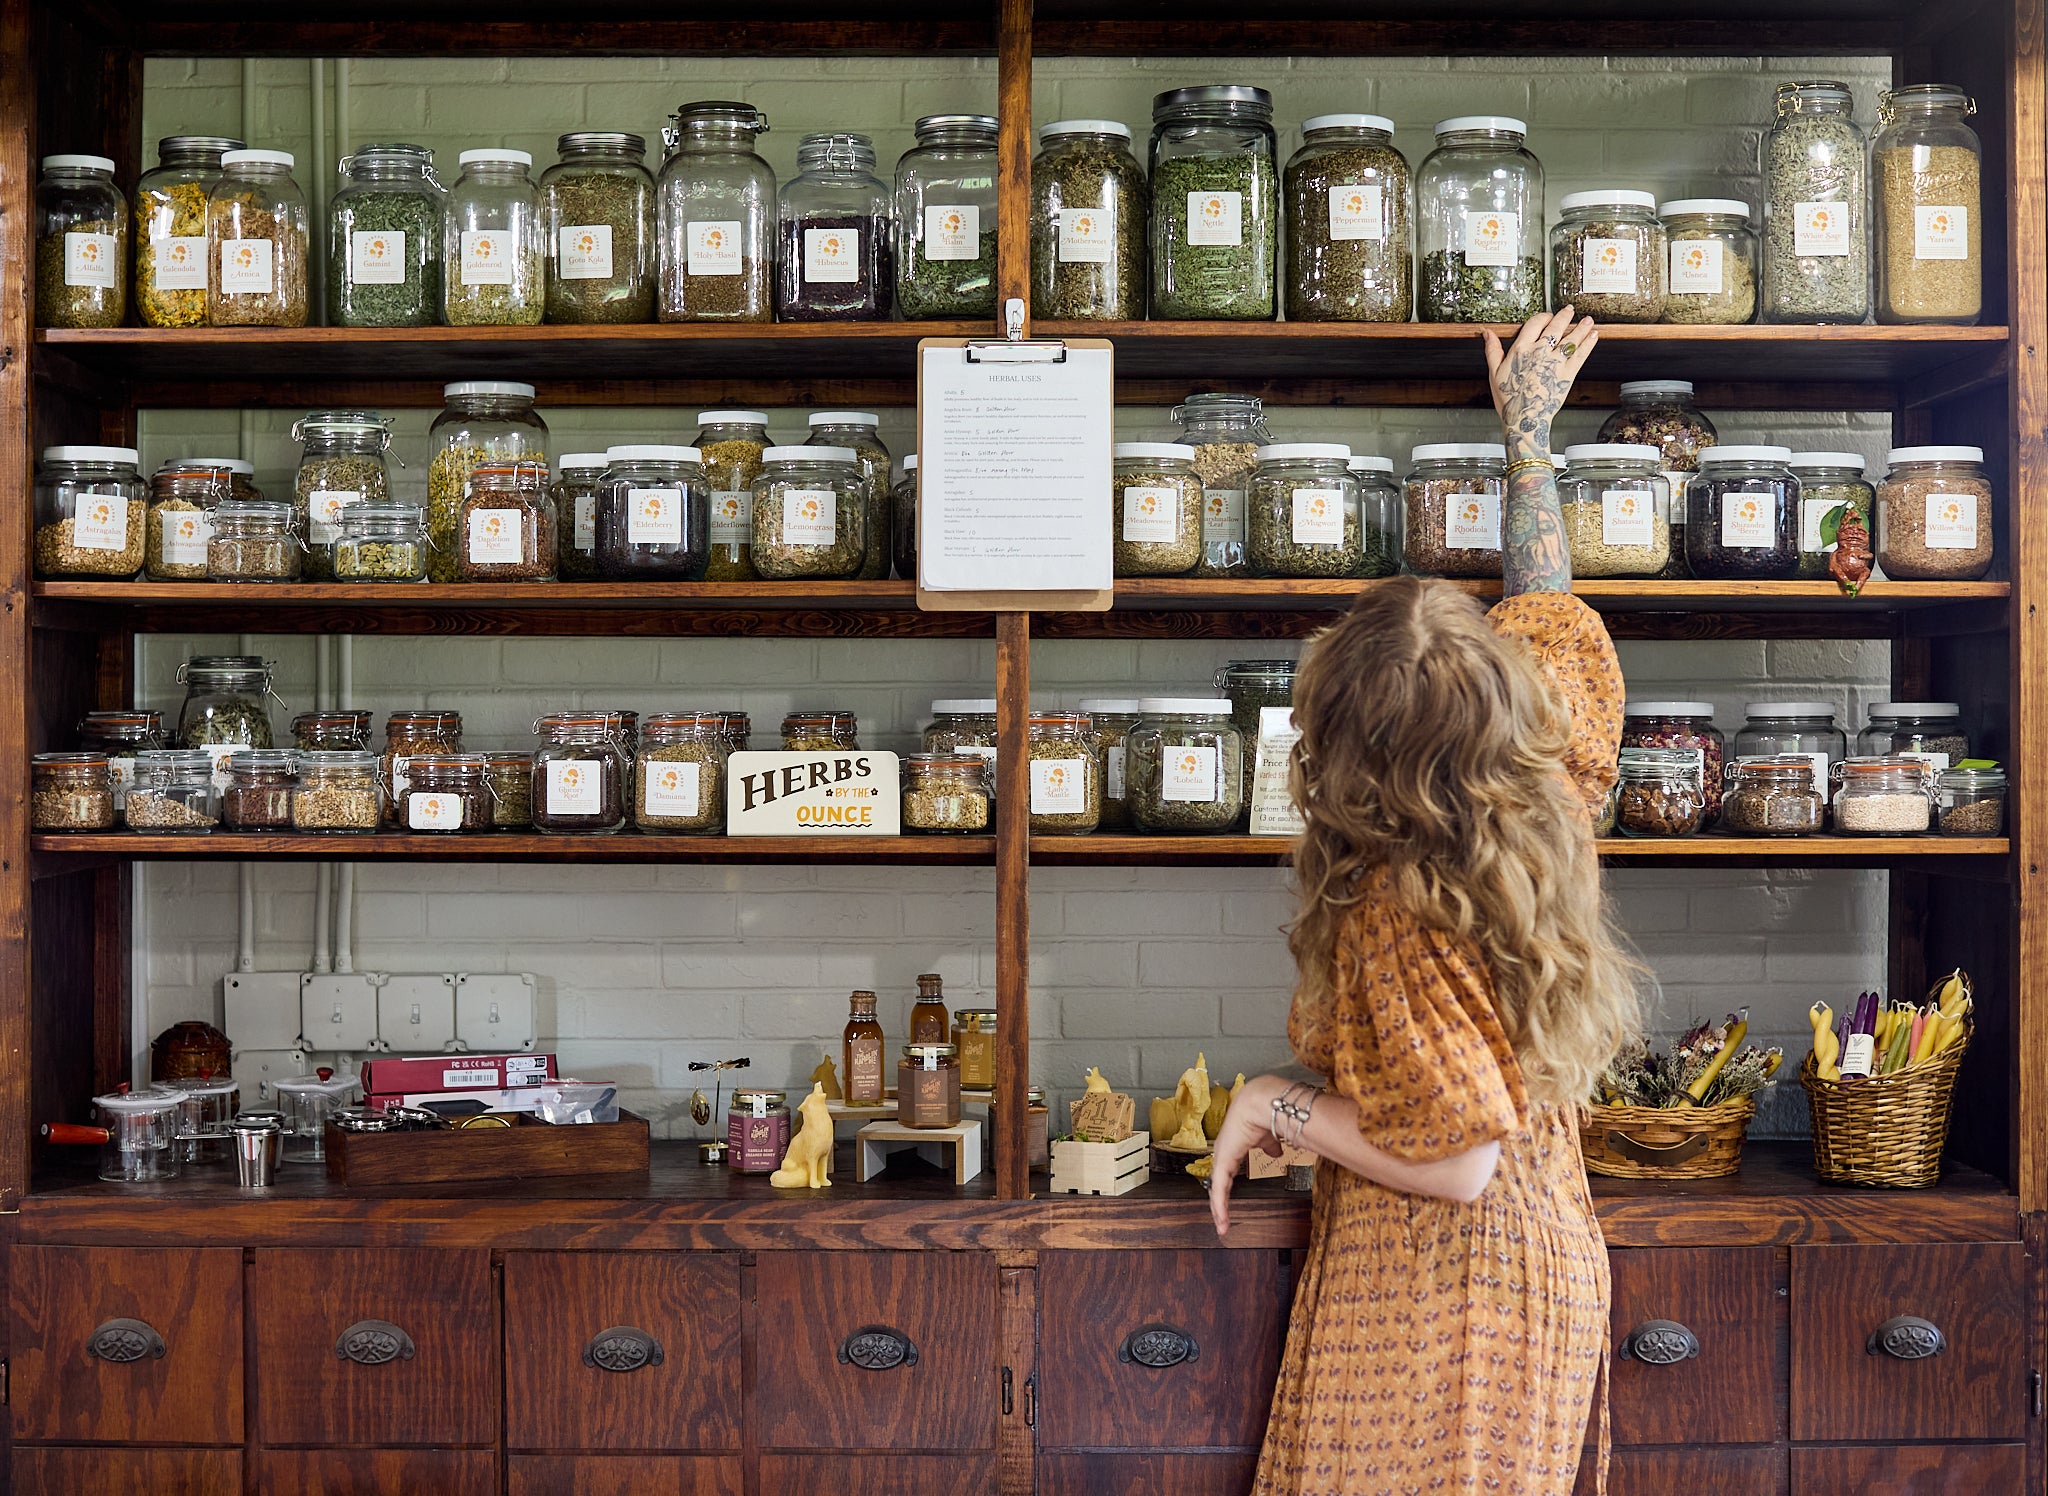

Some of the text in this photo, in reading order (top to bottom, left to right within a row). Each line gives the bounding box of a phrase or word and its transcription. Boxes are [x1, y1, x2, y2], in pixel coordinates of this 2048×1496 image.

[1263, 758, 1282, 767] Price
[740, 758, 872, 812] HERBS
[835, 788, 870, 798] BY THE
[796, 806, 872, 822] OUNCE
